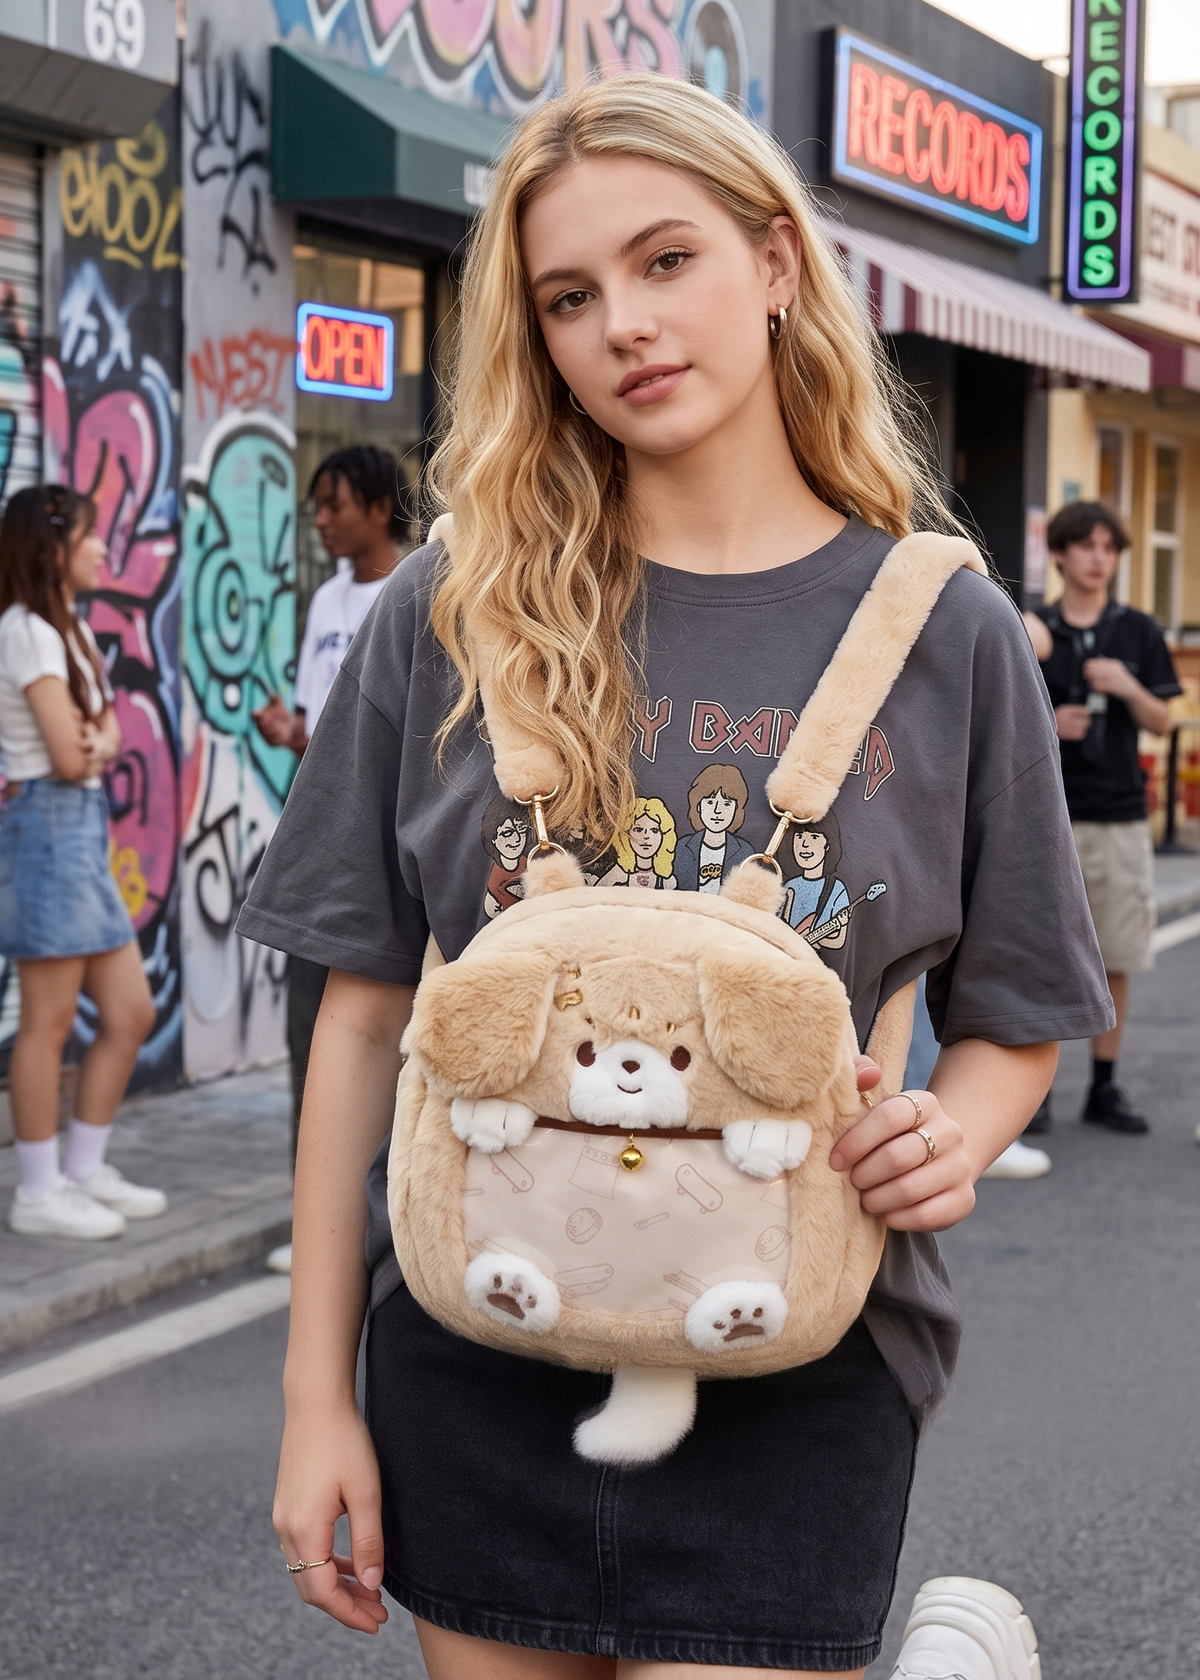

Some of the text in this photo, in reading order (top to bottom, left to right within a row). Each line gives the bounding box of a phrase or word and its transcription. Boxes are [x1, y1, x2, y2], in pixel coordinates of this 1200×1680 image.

[84, 0, 146, 69] 69
[849, 62, 1031, 222] RECORDS
[304, 315, 388, 389] OPEN
